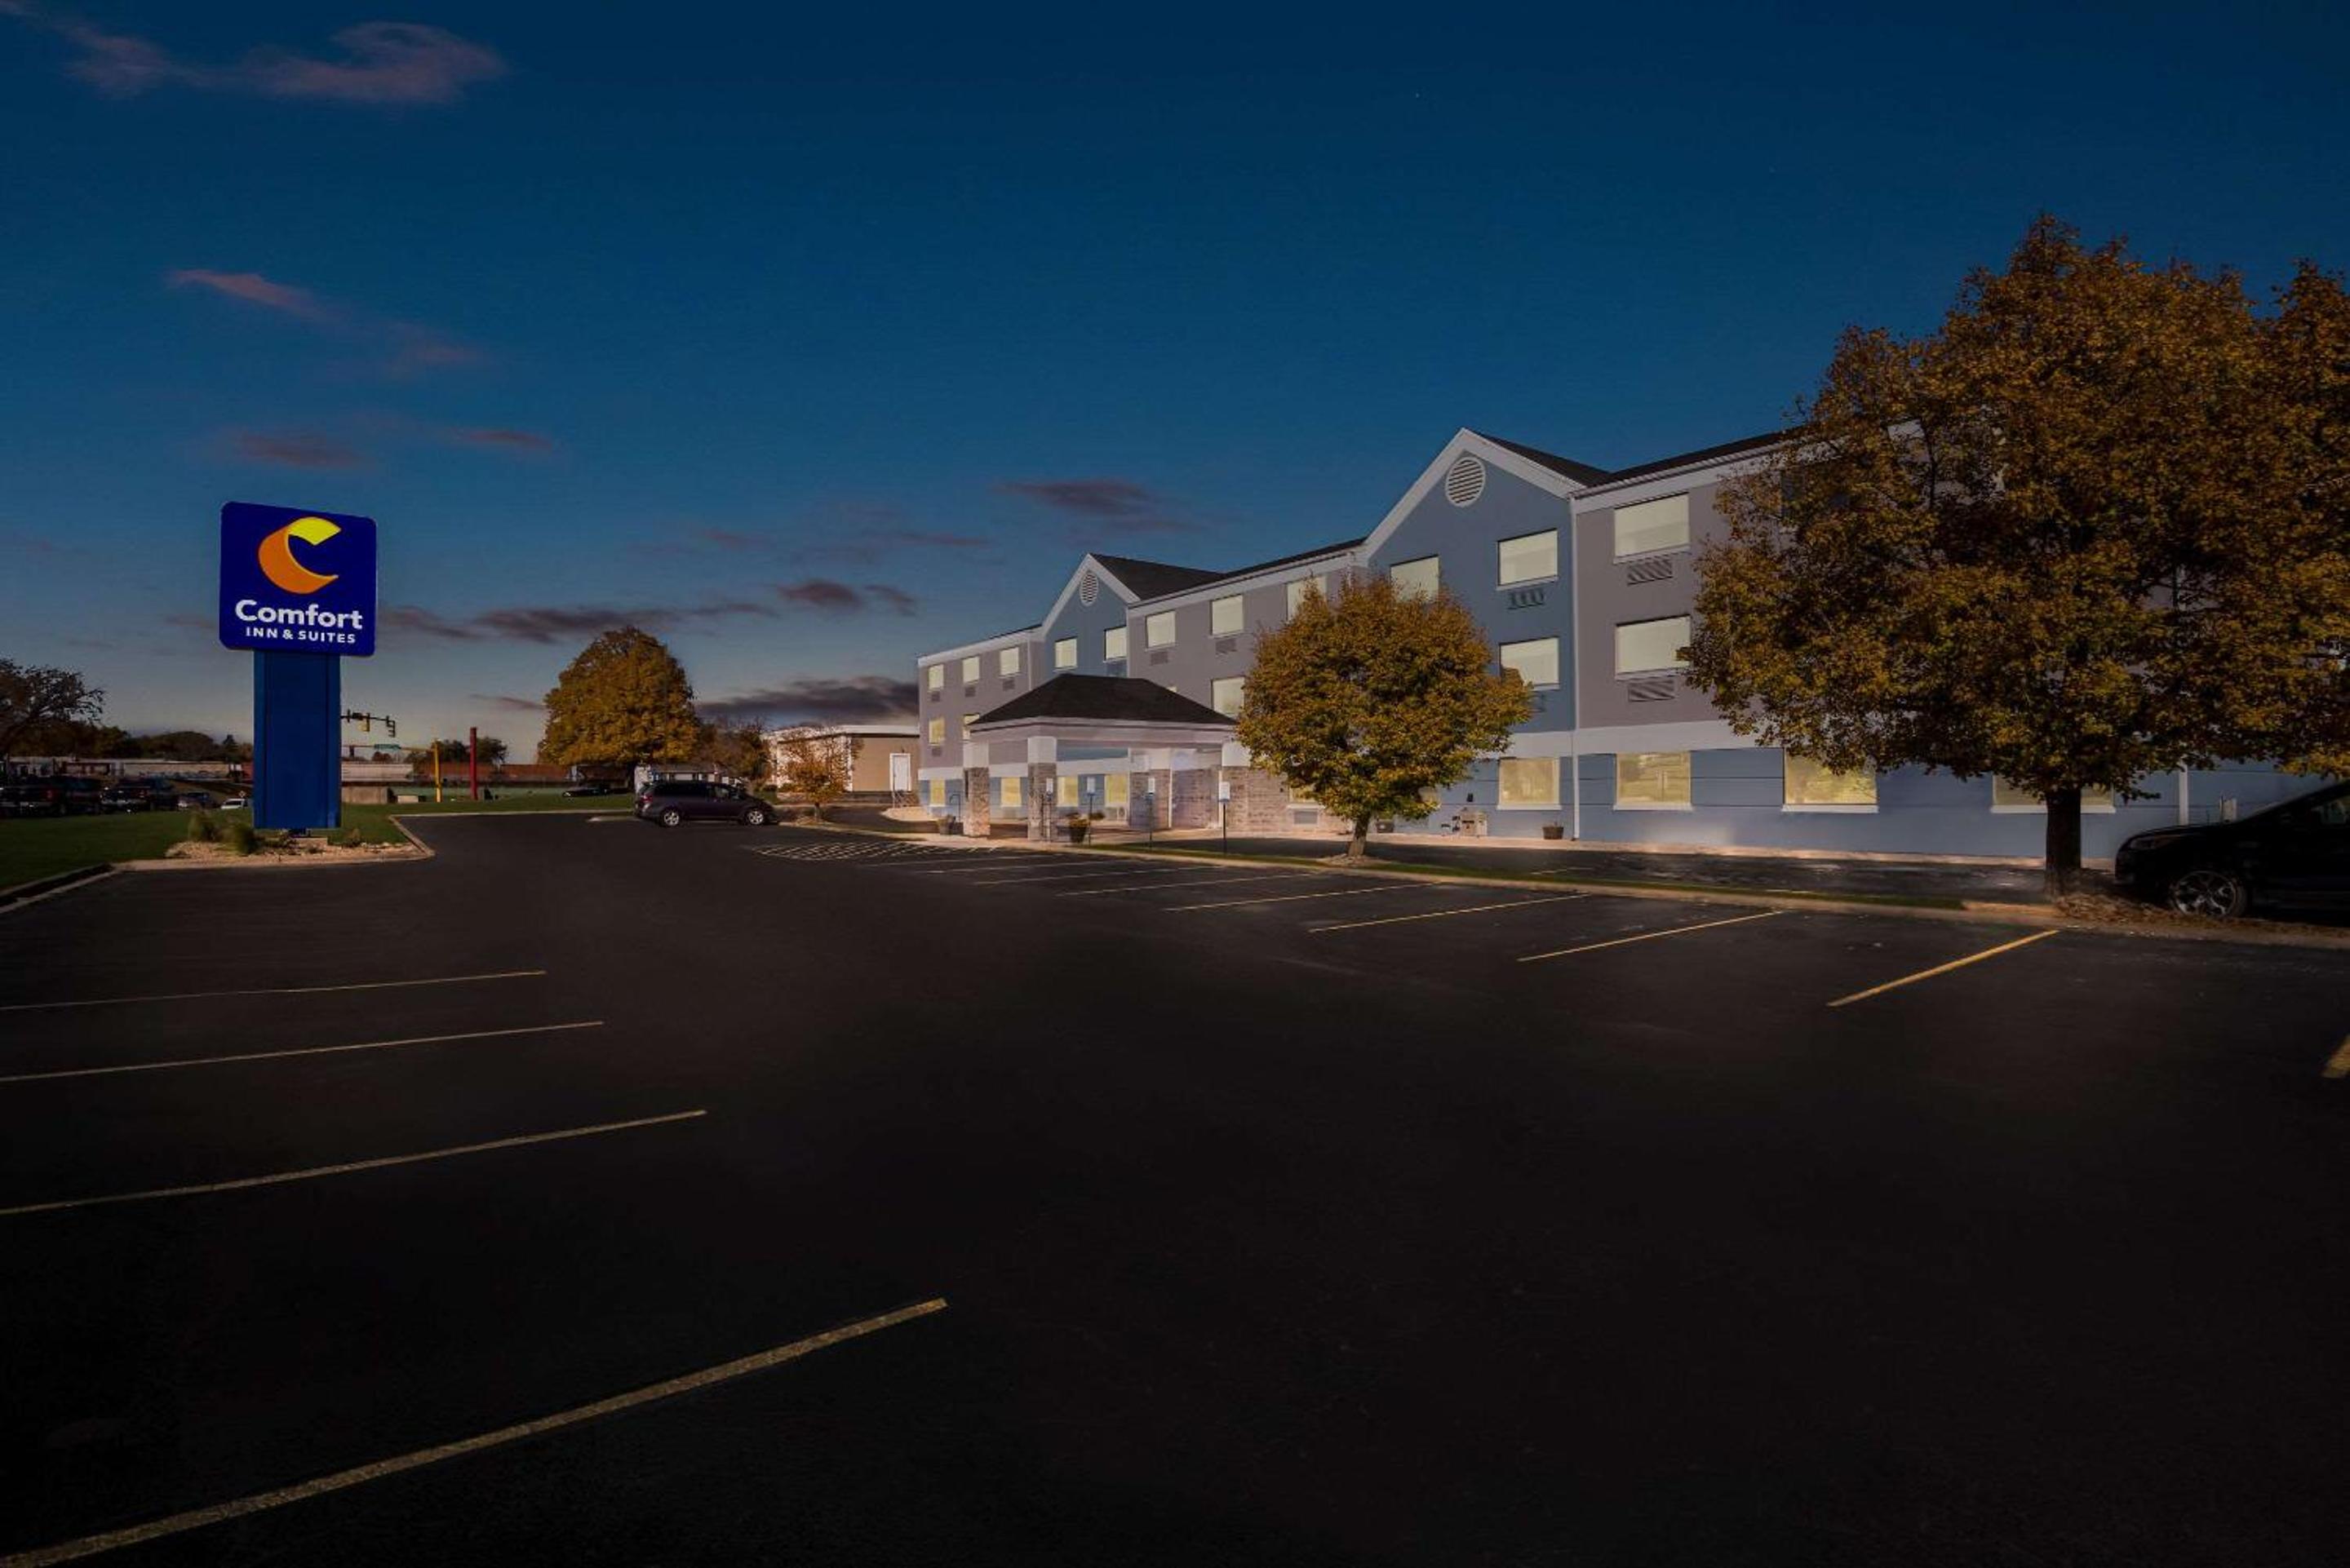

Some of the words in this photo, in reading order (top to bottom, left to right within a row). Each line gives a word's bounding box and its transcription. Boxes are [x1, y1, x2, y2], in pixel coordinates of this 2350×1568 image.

[235, 599, 363, 630] Comfort
[246, 627, 278, 639] INN
[282, 629, 294, 640] &
[298, 631, 357, 644] SUITES
